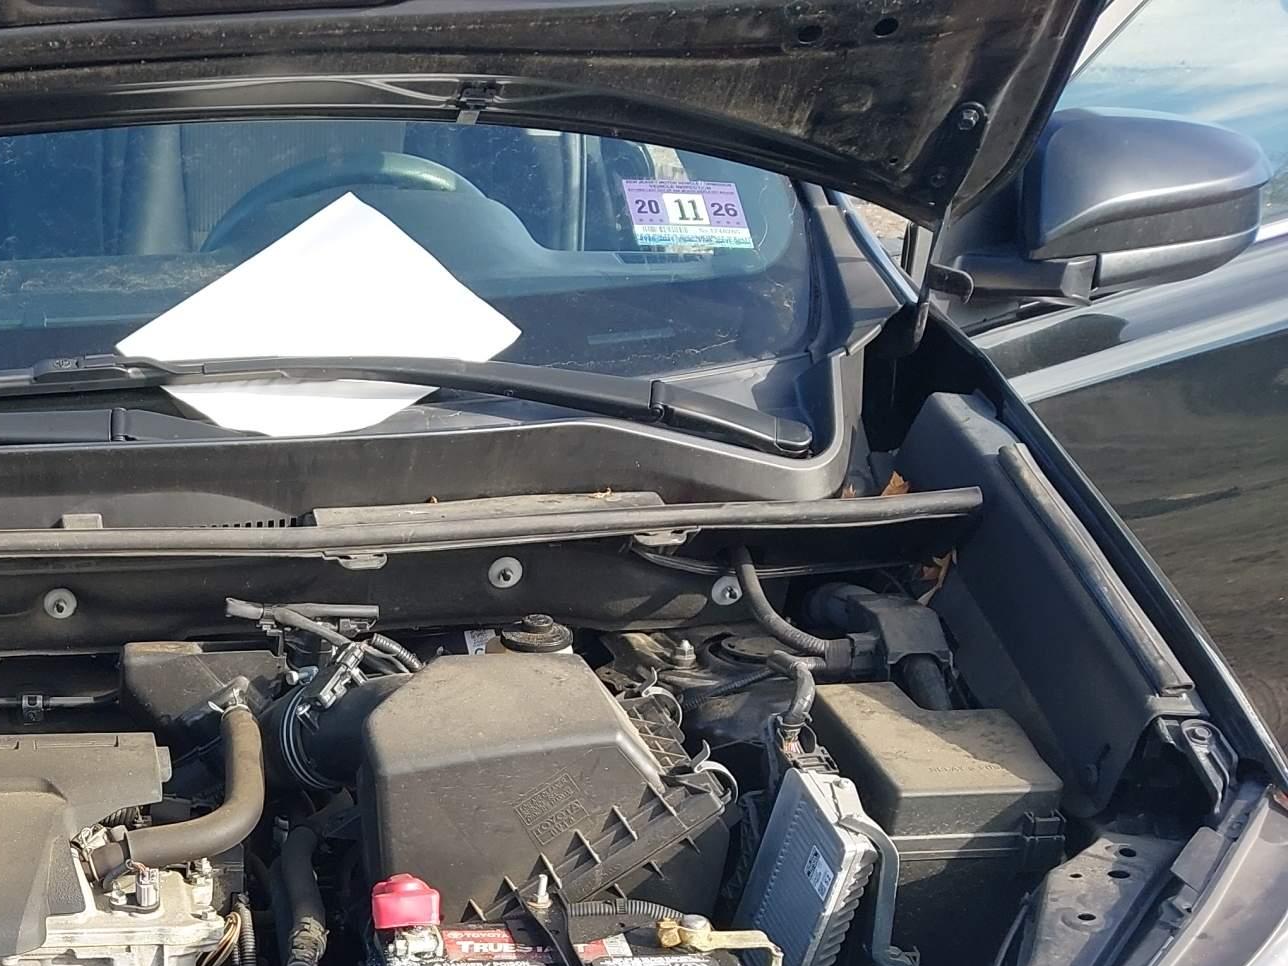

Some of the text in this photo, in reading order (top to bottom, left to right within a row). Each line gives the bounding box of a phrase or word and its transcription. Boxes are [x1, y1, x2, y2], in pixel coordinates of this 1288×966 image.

[635, 198, 738, 221] 20 11 26
